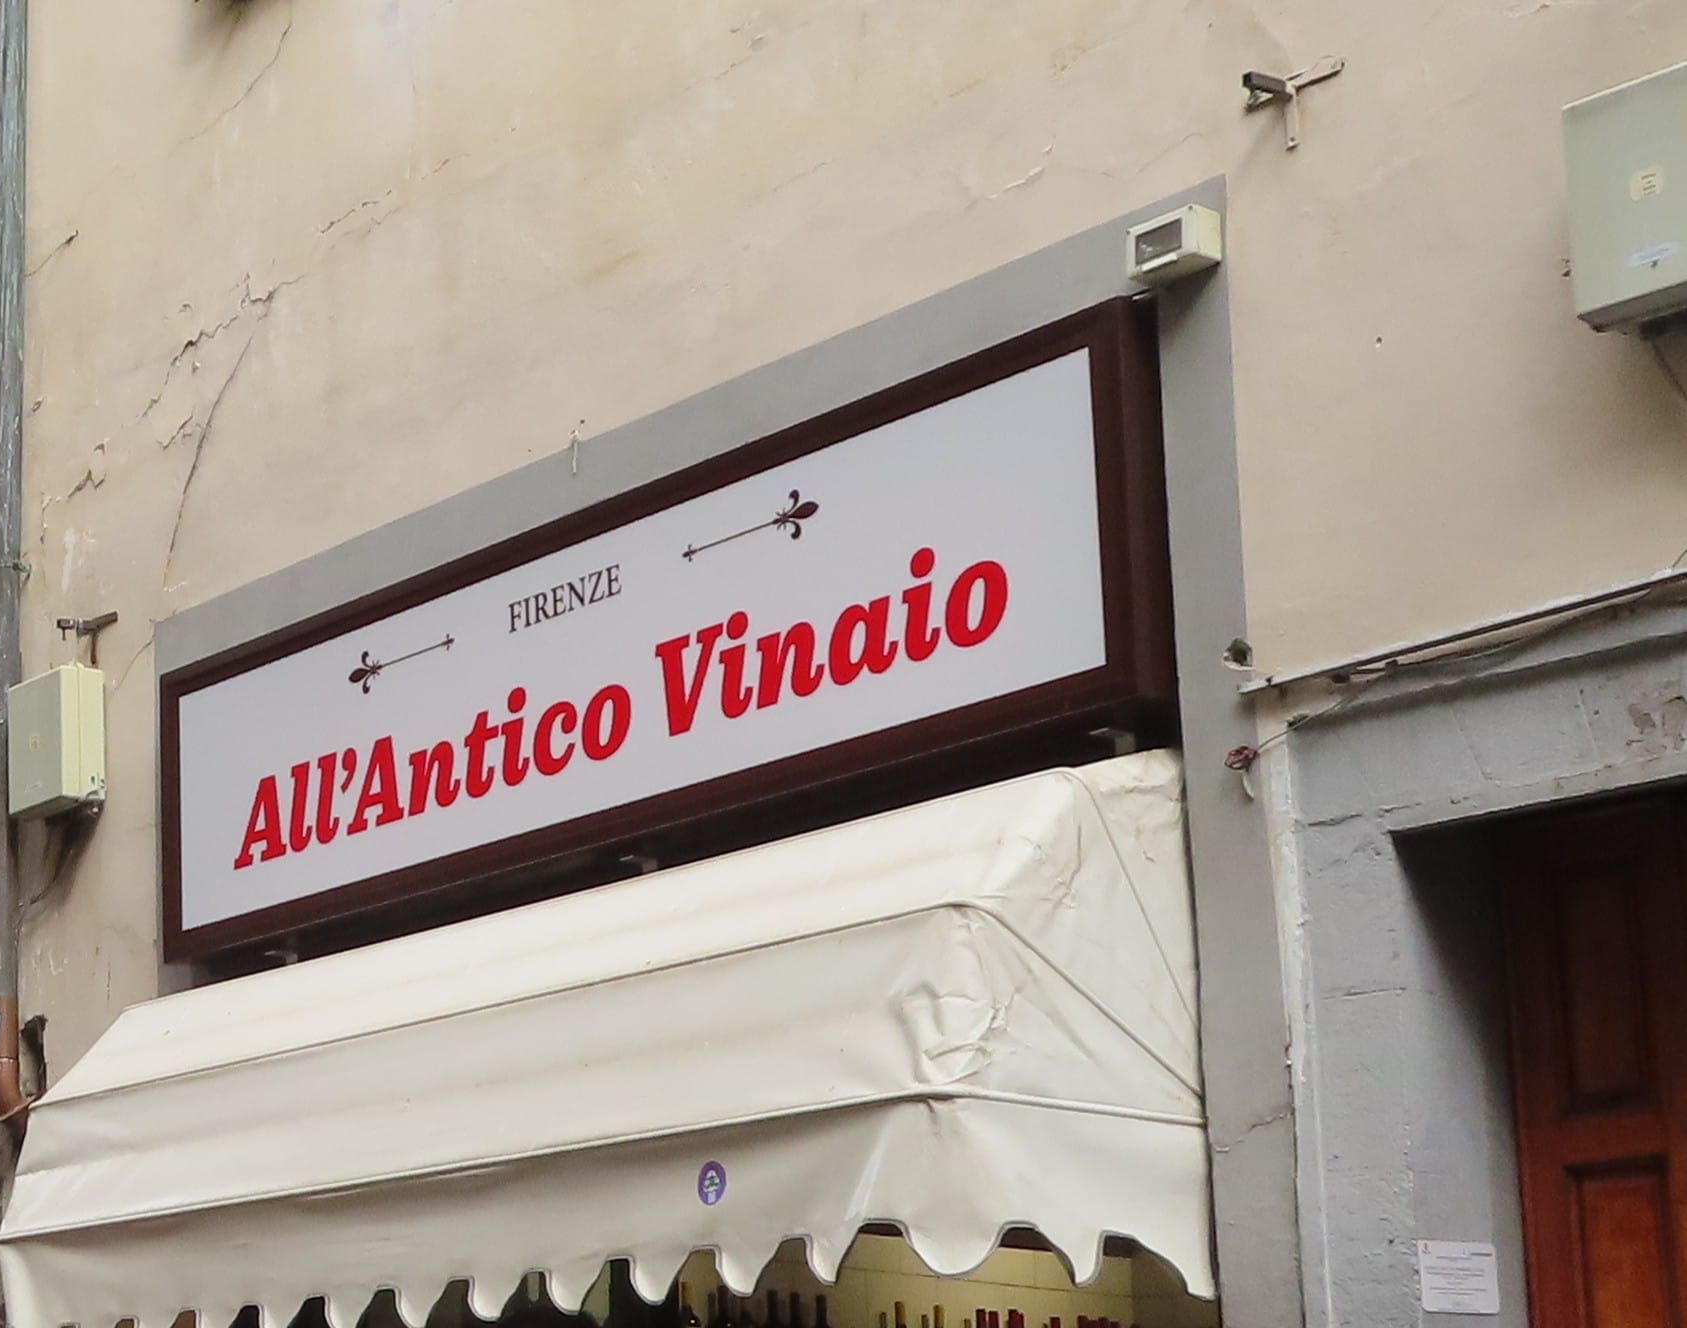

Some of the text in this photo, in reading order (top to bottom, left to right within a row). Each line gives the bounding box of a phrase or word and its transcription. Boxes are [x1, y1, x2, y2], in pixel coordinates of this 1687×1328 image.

[506, 563, 622, 634] FIRENZE
[233, 545, 1011, 870] All'Antico Vinaio
